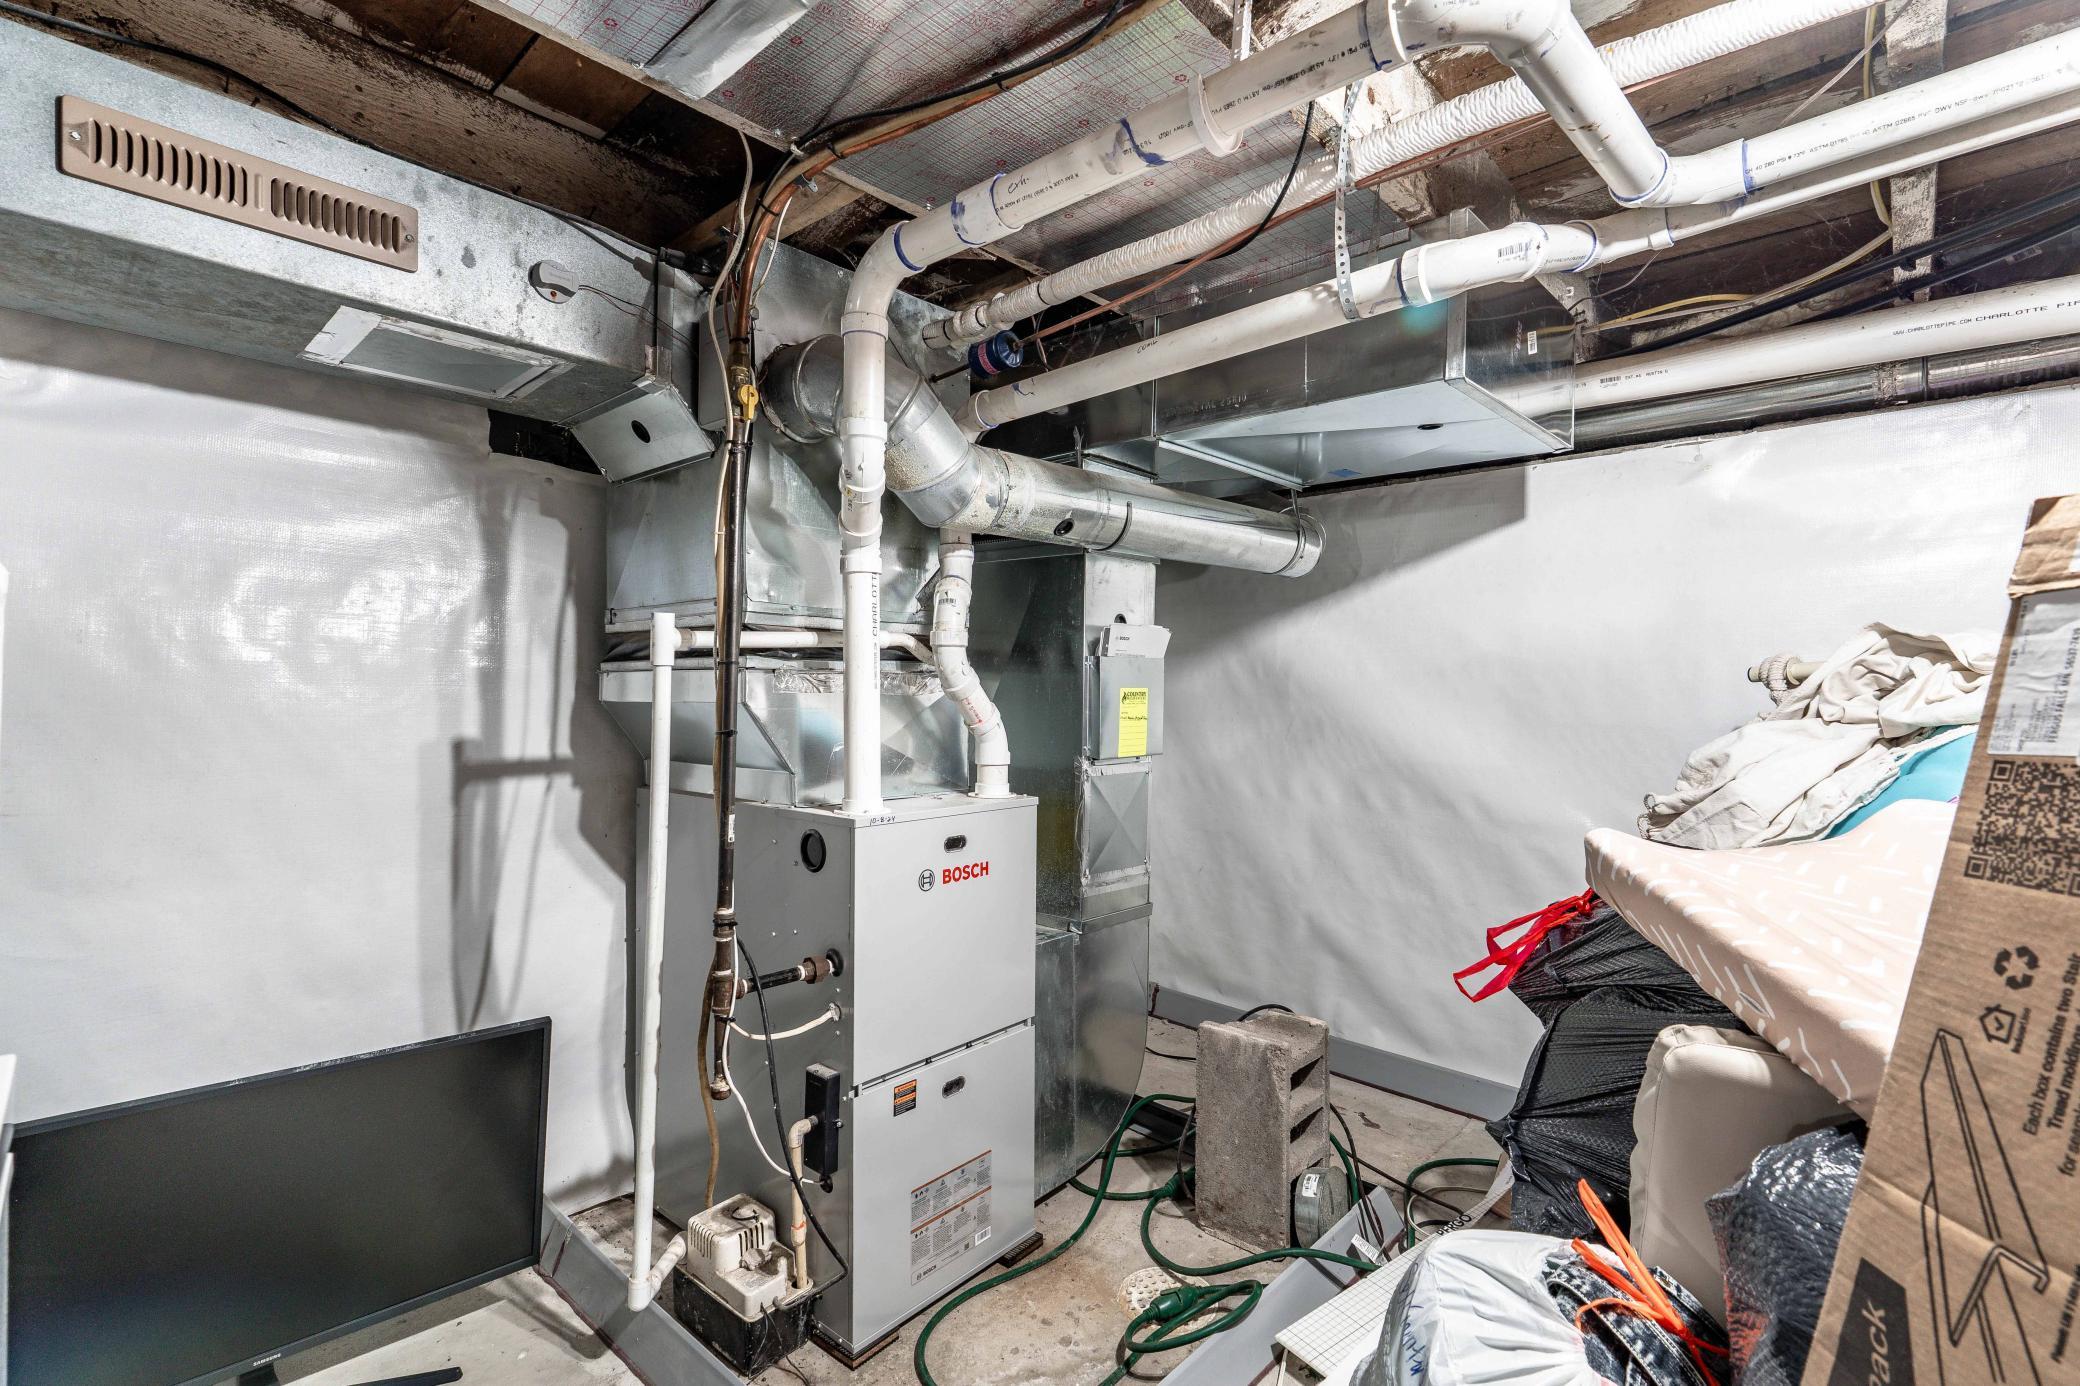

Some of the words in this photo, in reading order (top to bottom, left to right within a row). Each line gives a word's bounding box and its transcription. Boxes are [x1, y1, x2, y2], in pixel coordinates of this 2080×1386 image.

[1975, 305, 2049, 323] CHARLOTTE
[942, 860, 989, 885] BOSCH
[2056, 987, 2074, 1013] two
[2042, 1014, 2067, 1074] contains
[2036, 1072, 2051, 1102] box
[2023, 1097, 2044, 1136] Each
[2047, 1089, 2070, 1129] Tread
[2057, 1154, 2078, 1177] for
[1436, 1213, 1473, 1238] PERGO
[252, 1352, 282, 1367] SAMSUNG
